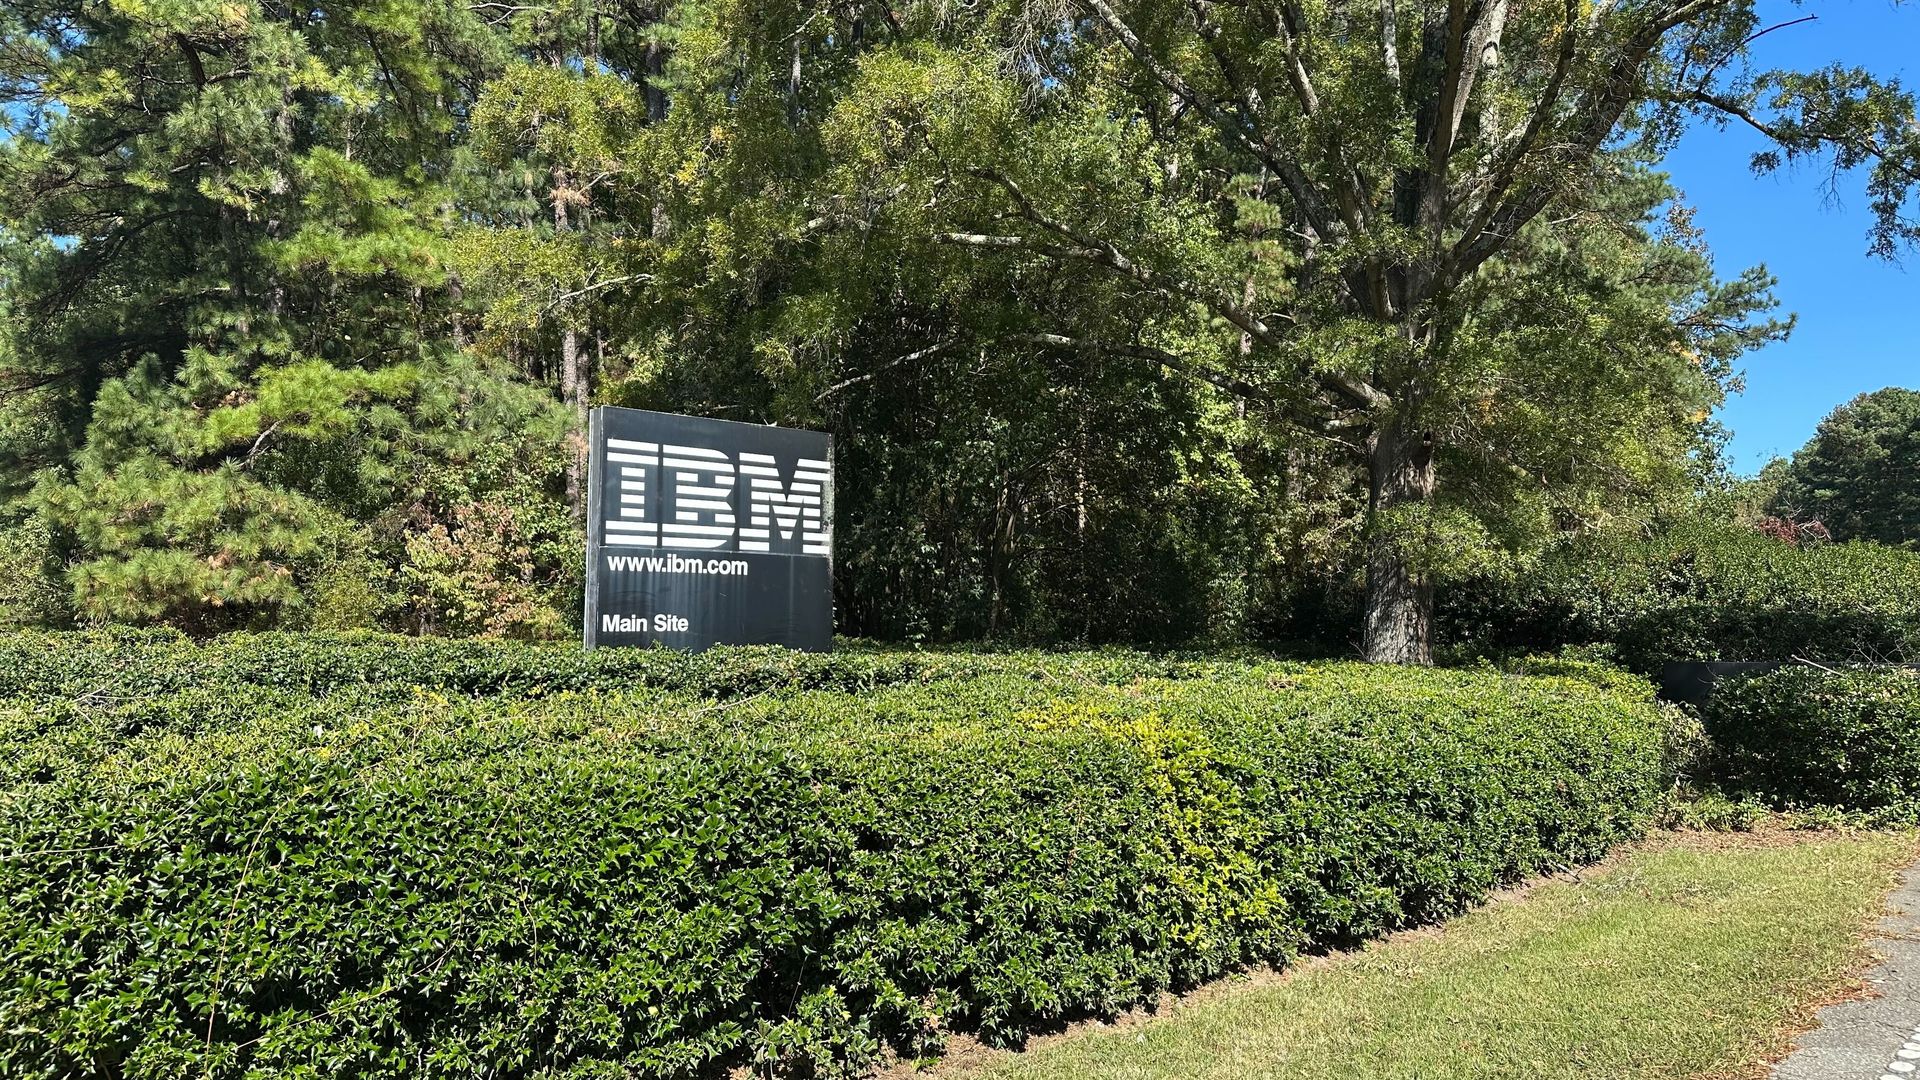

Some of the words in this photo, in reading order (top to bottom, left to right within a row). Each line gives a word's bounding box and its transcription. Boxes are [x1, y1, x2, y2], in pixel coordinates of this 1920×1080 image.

[605, 438, 831, 554] IBM
[607, 554, 748, 575] www.ibm.com
[602, 614, 648, 632] Main
[653, 613, 689, 632] Site
